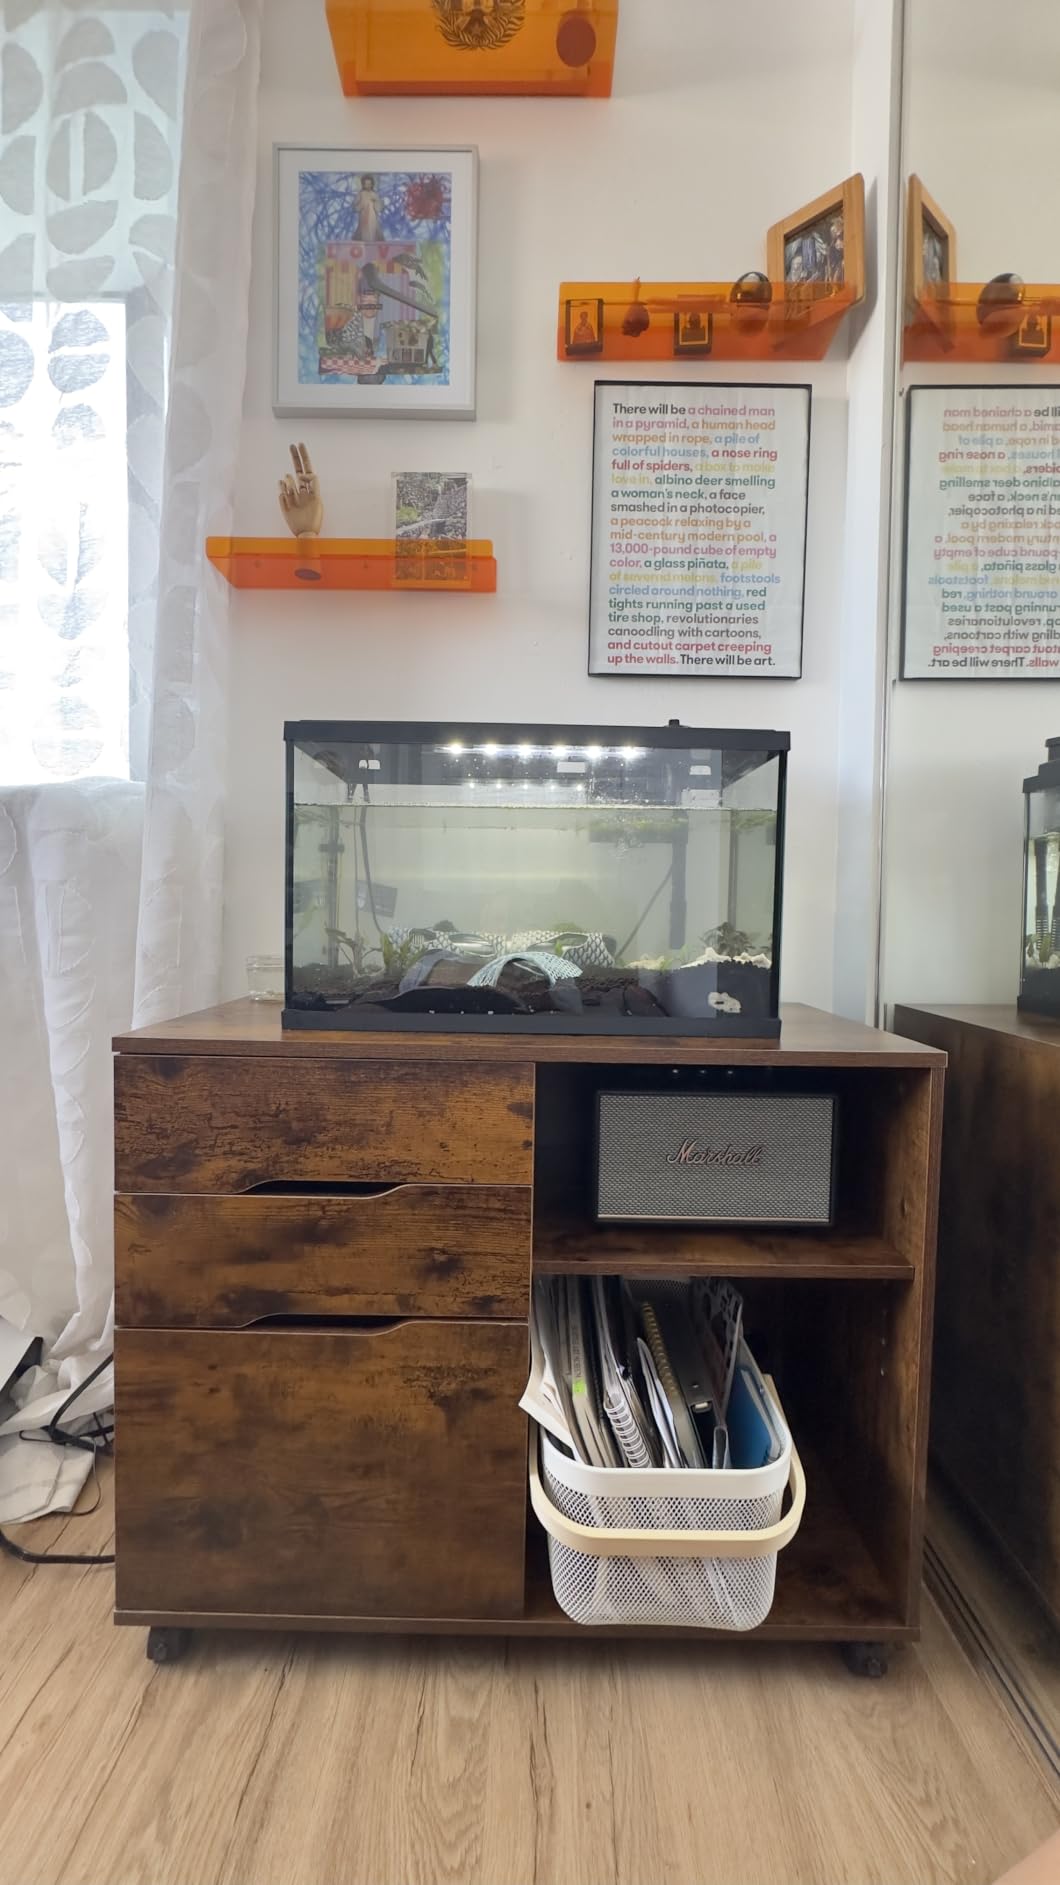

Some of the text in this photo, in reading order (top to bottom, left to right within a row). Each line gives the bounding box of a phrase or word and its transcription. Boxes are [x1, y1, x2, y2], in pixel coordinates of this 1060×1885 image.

[613, 404, 775, 416] There will be a chained man
[613, 417, 776, 432] in a pyramid, a human head
[612, 431, 760, 447] wrapped in rope, a pile of
[612, 445, 778, 461] colorful houses, a nose ring
[612, 459, 630, 471] full
[632, 459, 645, 471] of
[646, 460, 693, 474] spiders,
[654, 474, 692, 485] albino
[695, 474, 723, 486] deer
[725, 475, 776, 489] smelling
[611, 487, 746, 501] a woman's neck, a face
[611, 501, 765, 517] smashed in a photocopier,
[611, 515, 751, 531] a peacock relaxing by a
[610, 529, 777, 545] mid-century modern pool, a
[610, 543, 776, 559] 13,000-pound cube of empty
[610, 556, 642, 569] color,
[644, 560, 652, 568] a
[654, 557, 685, 571] glass
[688, 557, 729, 572] piñata,
[609, 570, 622, 582] of
[720, 572, 781, 584] footstools
[609, 584, 767, 600] circled around nothing, red
[608, 598, 765, 613] tights running past a used
[608, 611, 759, 626] tire shop, revolutionaries
[608, 625, 762, 640] canoodling with cartoons,
[608, 639, 772, 655] and cutout carpet creeping
[608, 653, 776, 667] up the walls. There will be art.
[666, 1137, 764, 1166] Marshall
